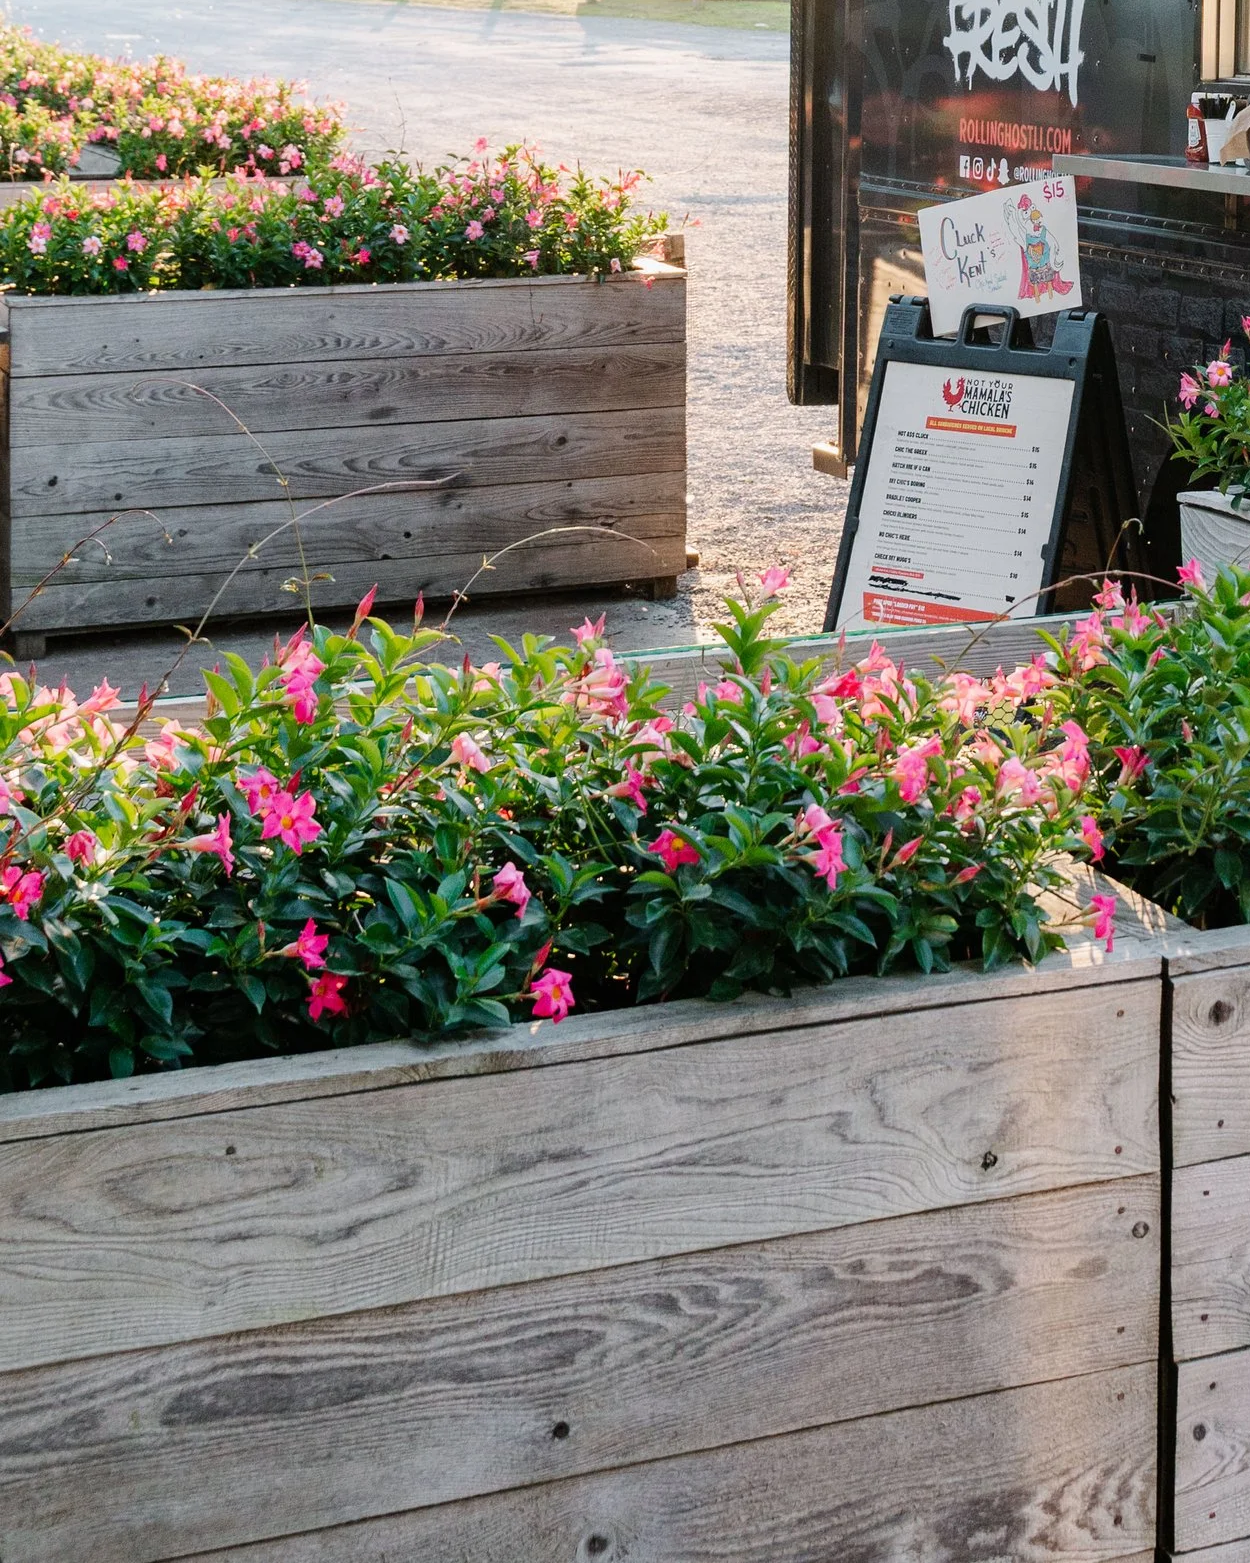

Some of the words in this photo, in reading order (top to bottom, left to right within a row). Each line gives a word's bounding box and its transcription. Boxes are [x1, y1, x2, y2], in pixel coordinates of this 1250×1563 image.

[959, 118, 1072, 154] ROLLINGHOSTLI.COM
[1043, 181, 1065, 203] $15
[966, 378, 985, 387] NOT
[989, 379, 1014, 390] YOUR
[964, 386, 1013, 403] MAMALA'S
[961, 399, 1011, 419] CHICKEN
